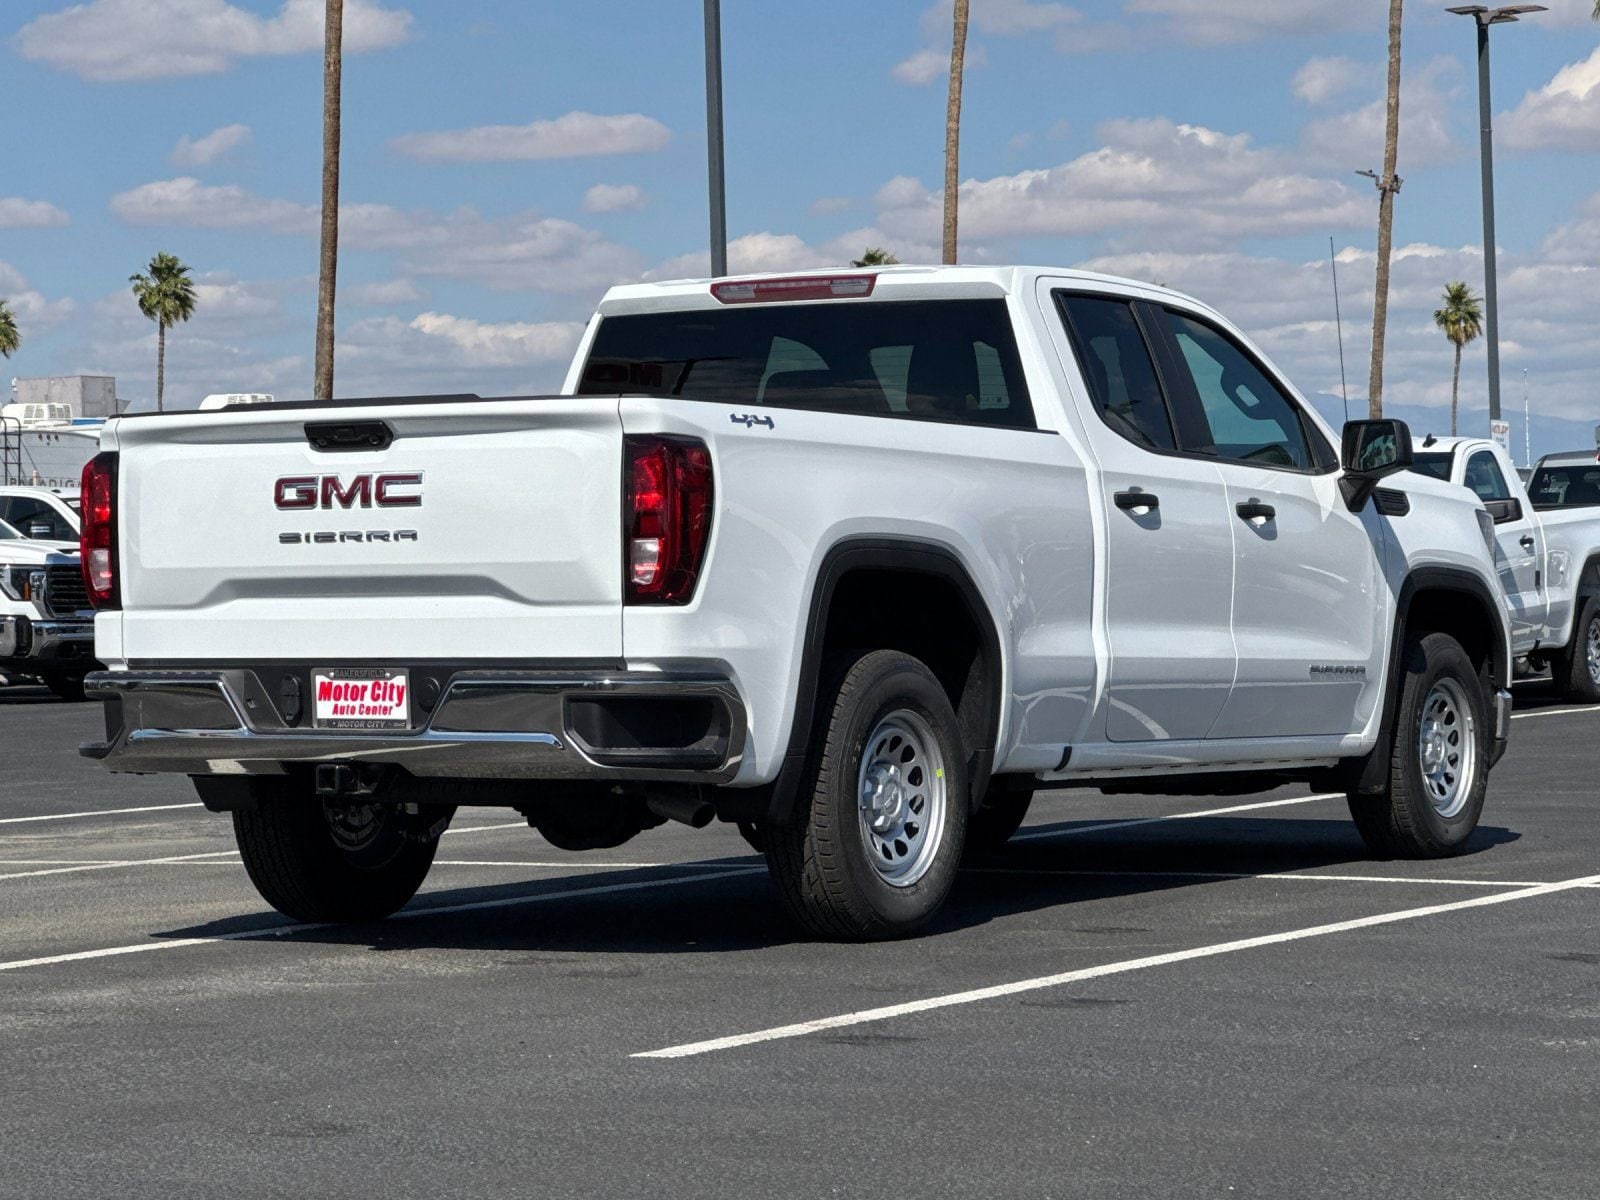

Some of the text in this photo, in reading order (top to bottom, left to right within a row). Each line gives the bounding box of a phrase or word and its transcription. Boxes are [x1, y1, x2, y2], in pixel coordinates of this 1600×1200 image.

[274, 472, 423, 511] GMC
[278, 529, 418, 544] SIERRA
[334, 669, 385, 678] BAKERSFIELD
[318, 680, 405, 707] Motor City
[332, 703, 393, 715] Auto Center
[337, 720, 365, 728] MOTOR
[367, 720, 386, 728] CITY
